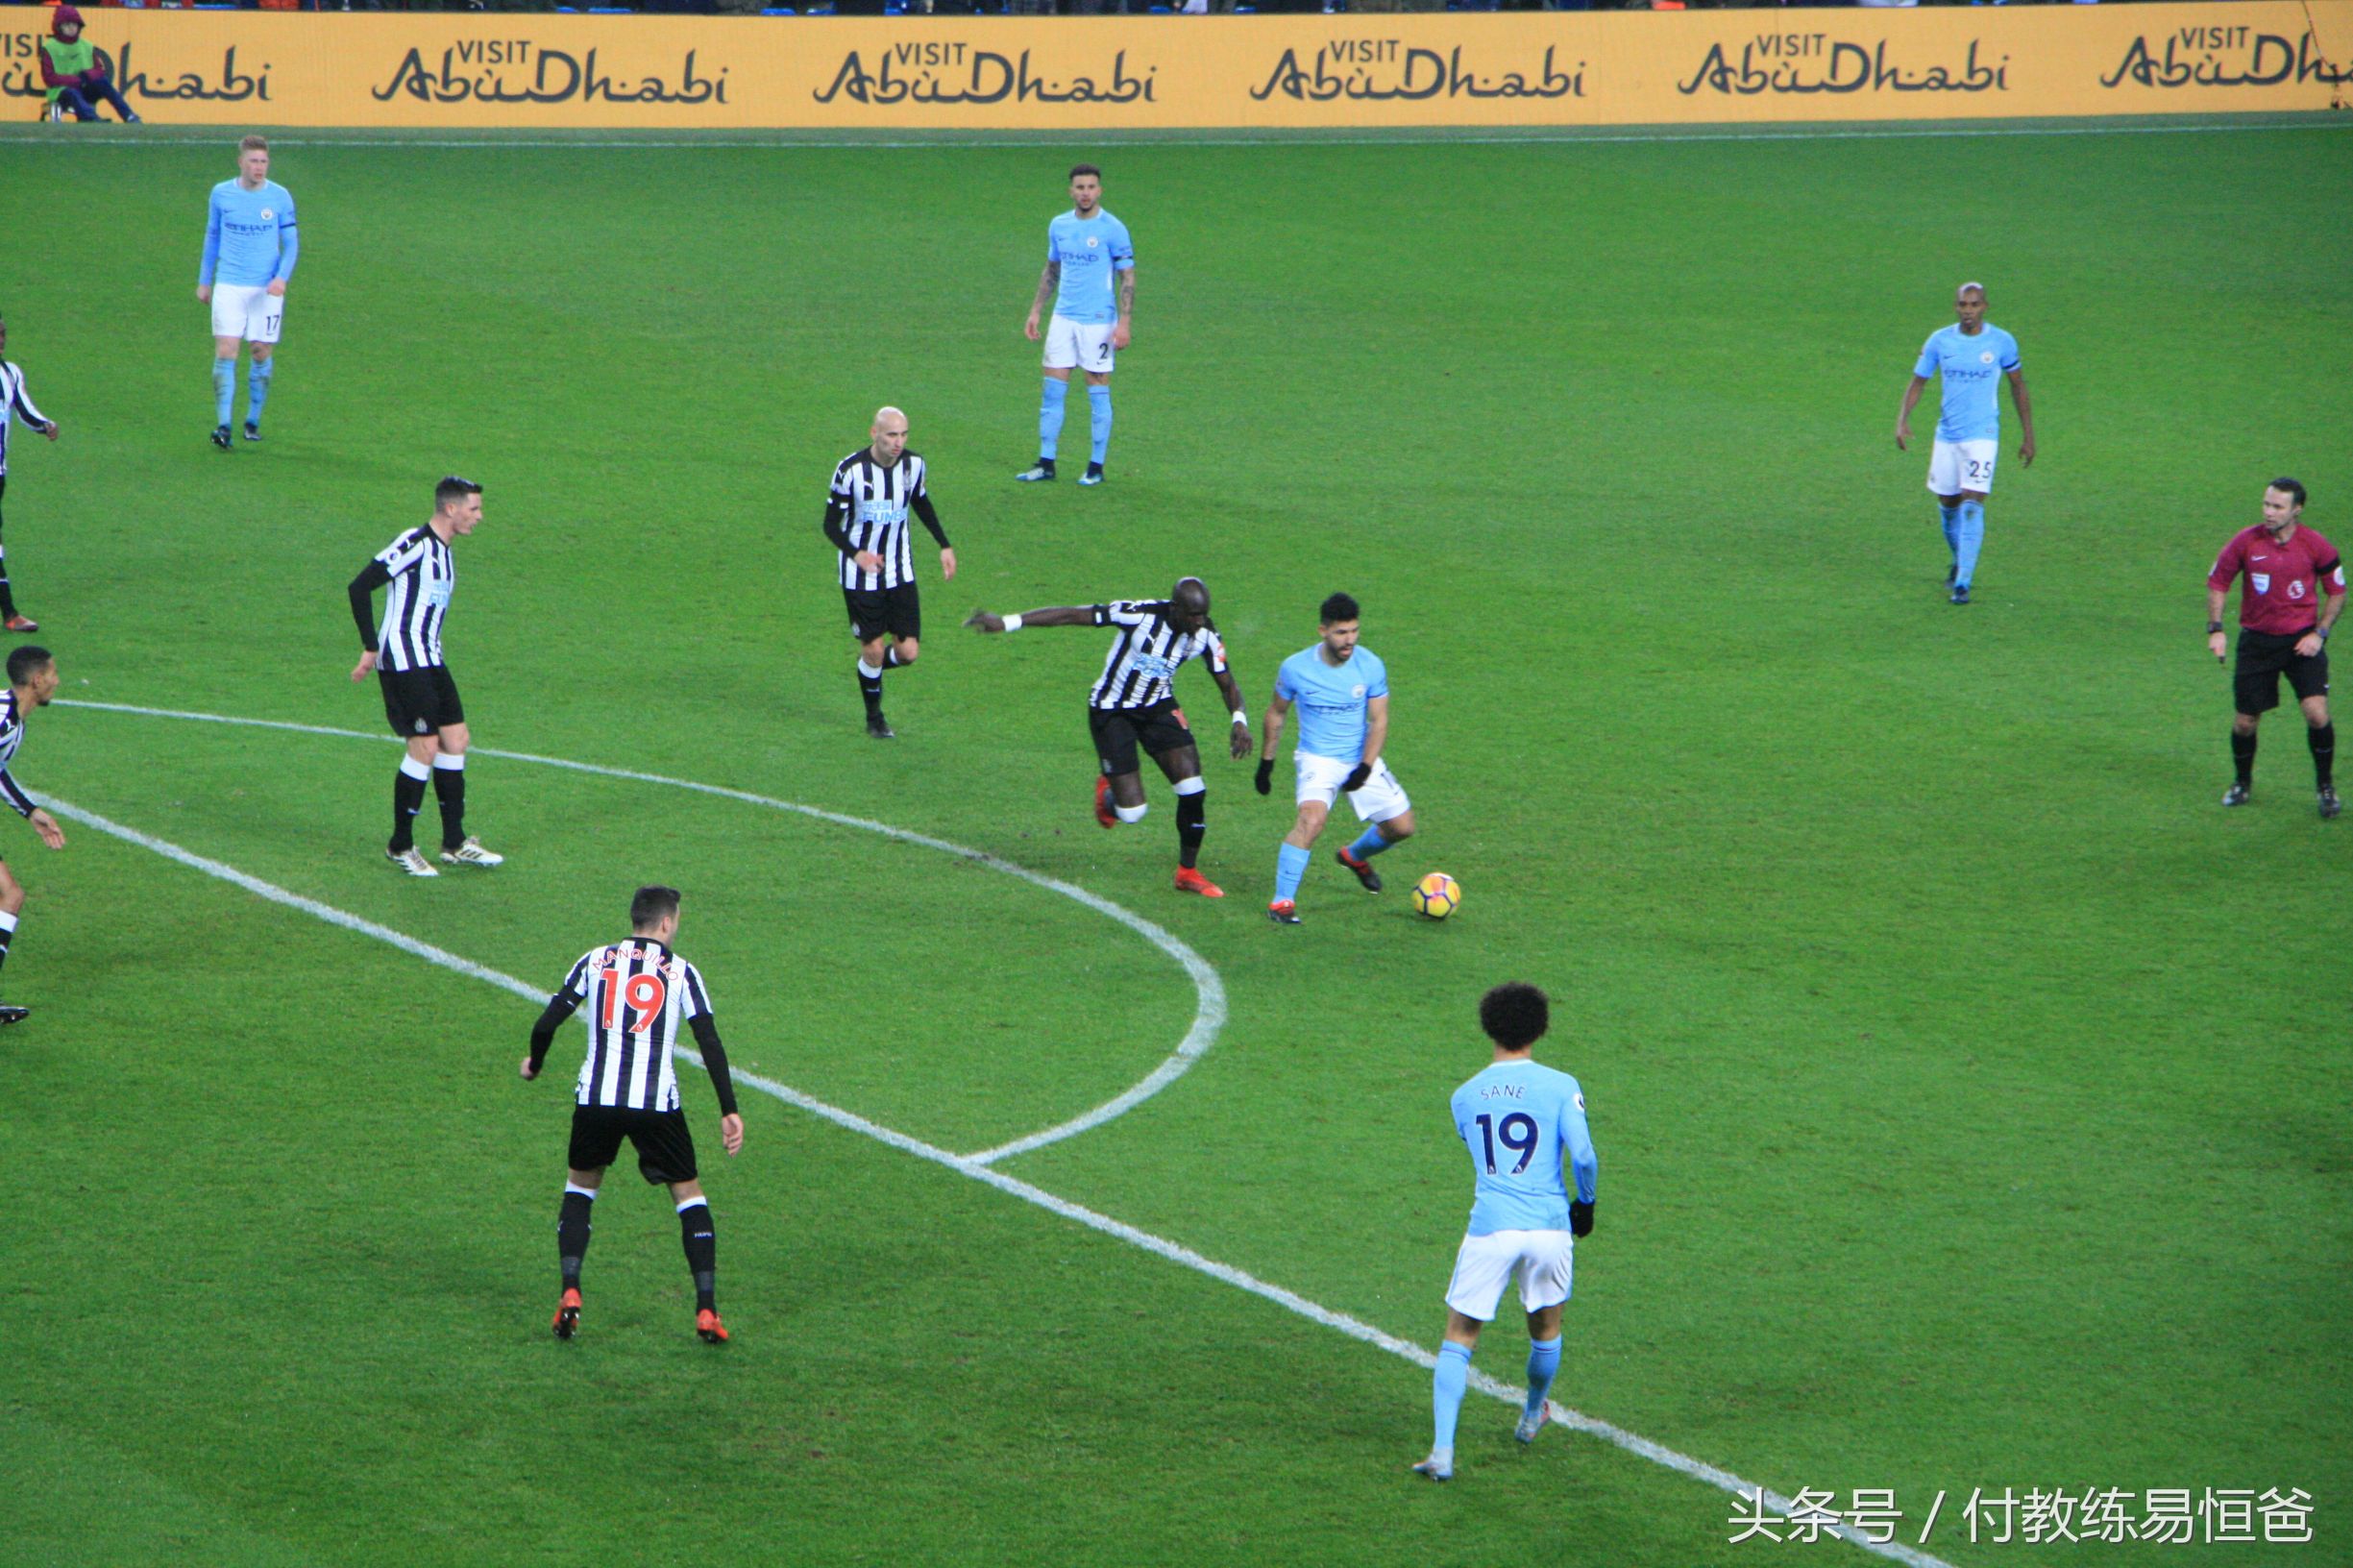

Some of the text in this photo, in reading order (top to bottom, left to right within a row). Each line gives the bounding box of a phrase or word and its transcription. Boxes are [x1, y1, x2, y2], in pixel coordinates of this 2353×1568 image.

[1756, 33, 1826, 57] VISIT
[2180, 26, 2250, 49] VISIT
[456, 39, 531, 64] VISIT
[895, 42, 968, 65] VISIT
[1330, 39, 1400, 62] VISIT
[266, 314, 280, 331] 17
[1098, 342, 1109, 360] 2
[1970, 460, 1992, 478] 25
[592, 947, 679, 981] MANQUILLO
[601, 968, 666, 1034] 19
[1475, 1111, 1540, 1176] 19
